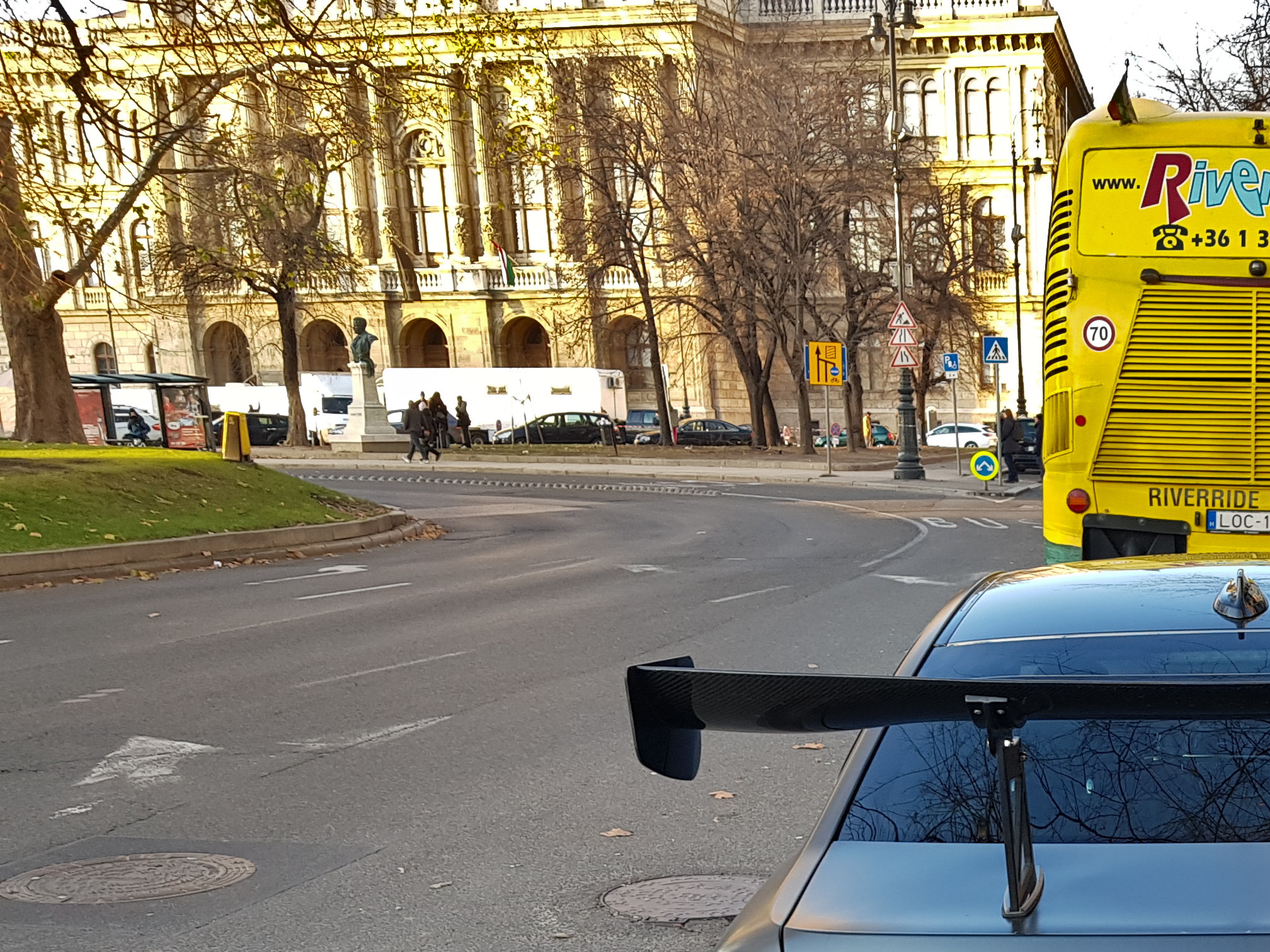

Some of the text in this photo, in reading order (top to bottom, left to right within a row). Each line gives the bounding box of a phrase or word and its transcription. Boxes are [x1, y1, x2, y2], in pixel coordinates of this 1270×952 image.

[1191, 229, 1230, 248] +36
[1238, 229, 1247, 248] 1
[1089, 326, 1108, 341] 70
[1148, 487, 1260, 509] RIVERRIDE
